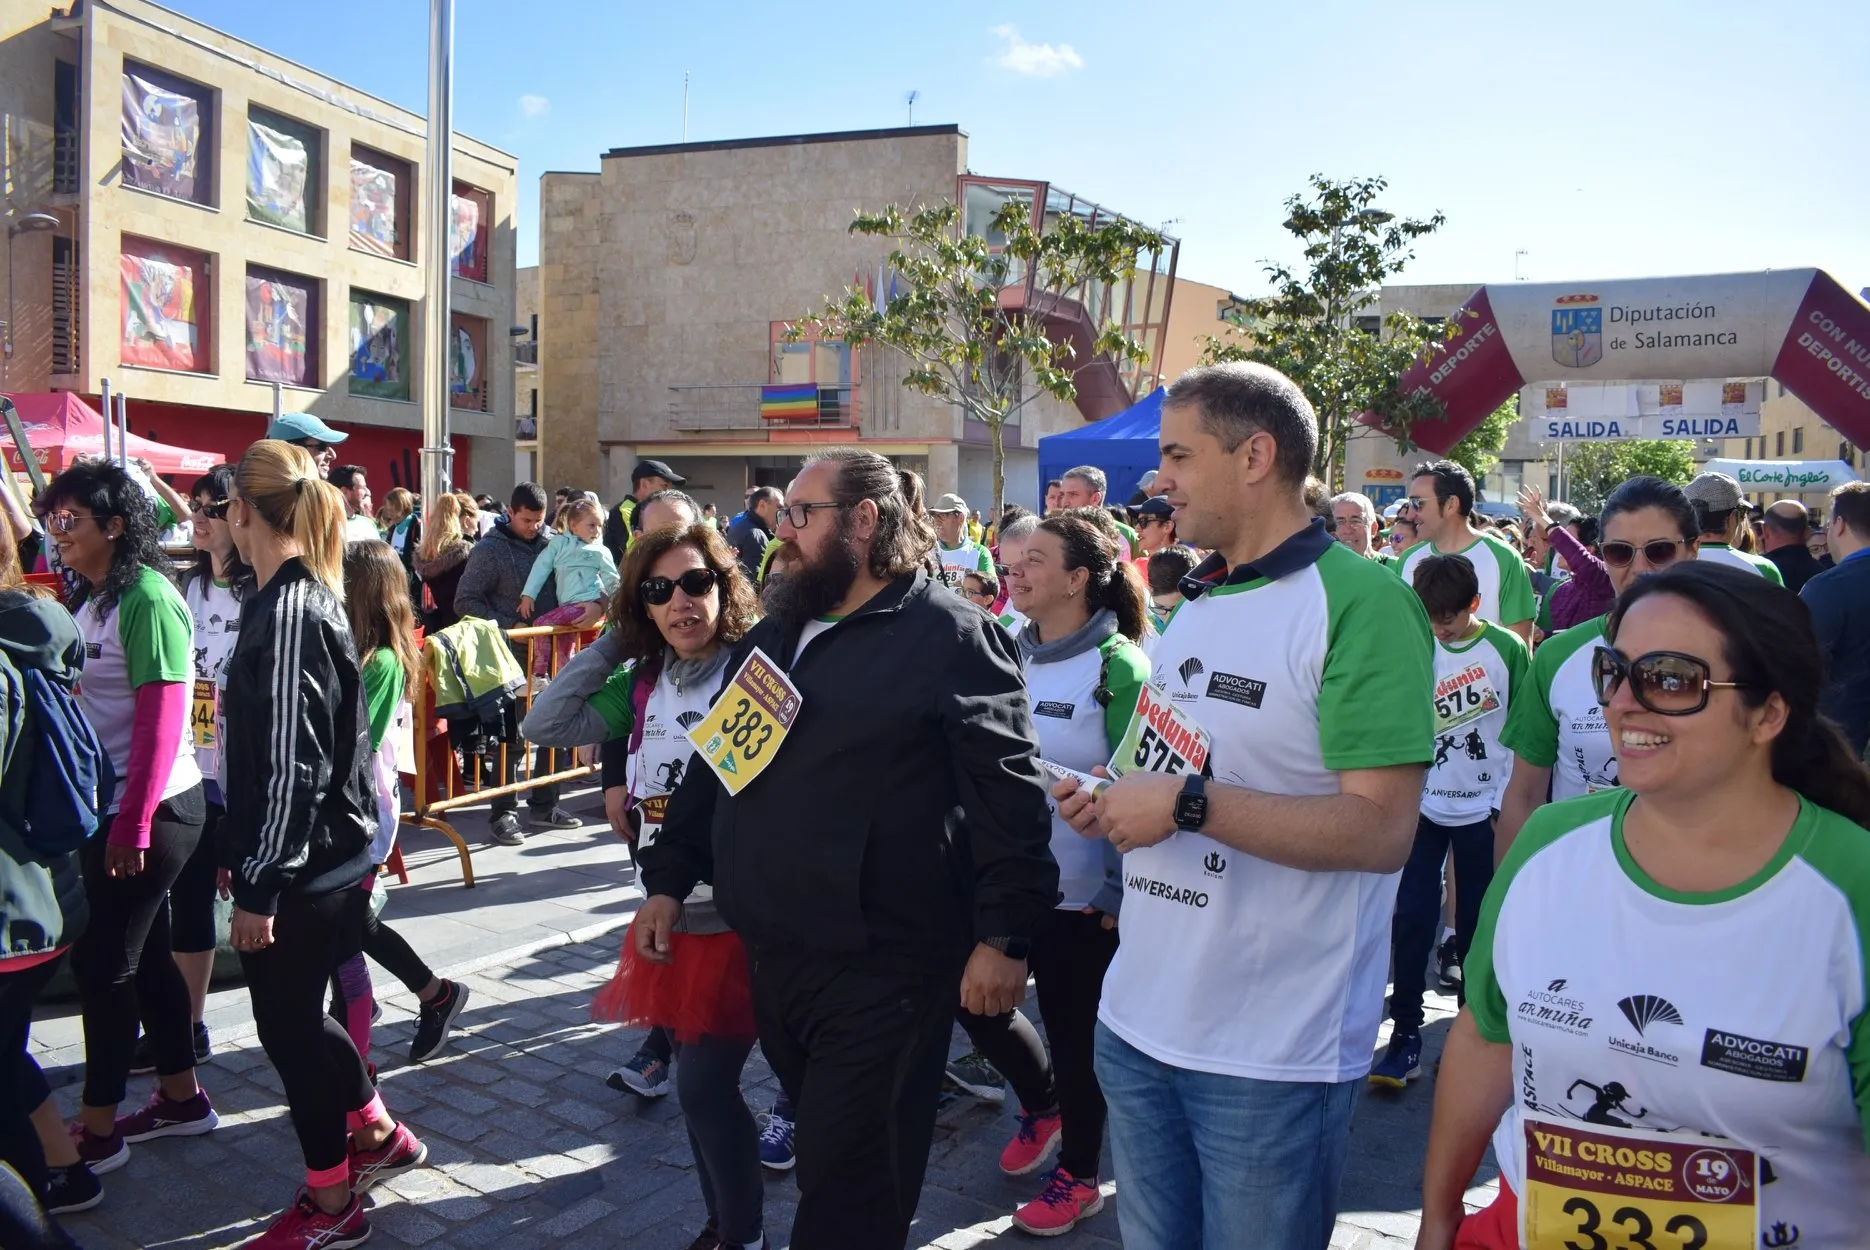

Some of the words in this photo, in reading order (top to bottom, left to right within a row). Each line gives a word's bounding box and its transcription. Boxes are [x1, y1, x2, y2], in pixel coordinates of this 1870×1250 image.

[1610, 302, 1716, 326] Diputación
[1809, 310, 1847, 342] CON
[1610, 337, 1626, 350] de
[1635, 330, 1737, 349] Salamanca
[1429, 321, 1496, 385] DEPORTE
[1548, 421, 1622, 438] SALIDA
[1662, 418, 1739, 436] SALIDA
[1738, 468, 1751, 483] El
[1753, 469, 1783, 483] Corte
[1783, 466, 1829, 487] Inglés
[751, 660, 766, 679] VII
[762, 673, 787, 702] CROSS
[1213, 674, 1262, 691] ADVOCATI
[1218, 684, 1250, 695] ABOGADOS
[785, 699, 794, 713] 19
[1040, 702, 1072, 710] ADVOCATI
[1434, 684, 1481, 718] 576
[721, 698, 773, 761] 383
[1136, 685, 1206, 772] bedunia
[1431, 789, 1481, 799] ANIVERSARIO
[1128, 875, 1209, 908] ANIVERSARIO
[1527, 990, 1585, 1011] AUTOCARES
[1608, 1036, 1646, 1054] Unicaja
[1648, 1046, 1679, 1062] Banco
[1711, 1033, 1802, 1061] ADVOCATI
[1725, 1049, 1784, 1067] ABOGADOS
[1522, 1043, 1540, 1112] ASPACE
[1534, 1131, 1572, 1157] VII
[1577, 1141, 1672, 1173] CROSS
[1535, 1155, 1604, 1181] Villamayor
[1614, 1172, 1674, 1192] ASPACE
[1696, 1158, 1729, 1180] 19
[1696, 1184, 1730, 1196] MAYO
